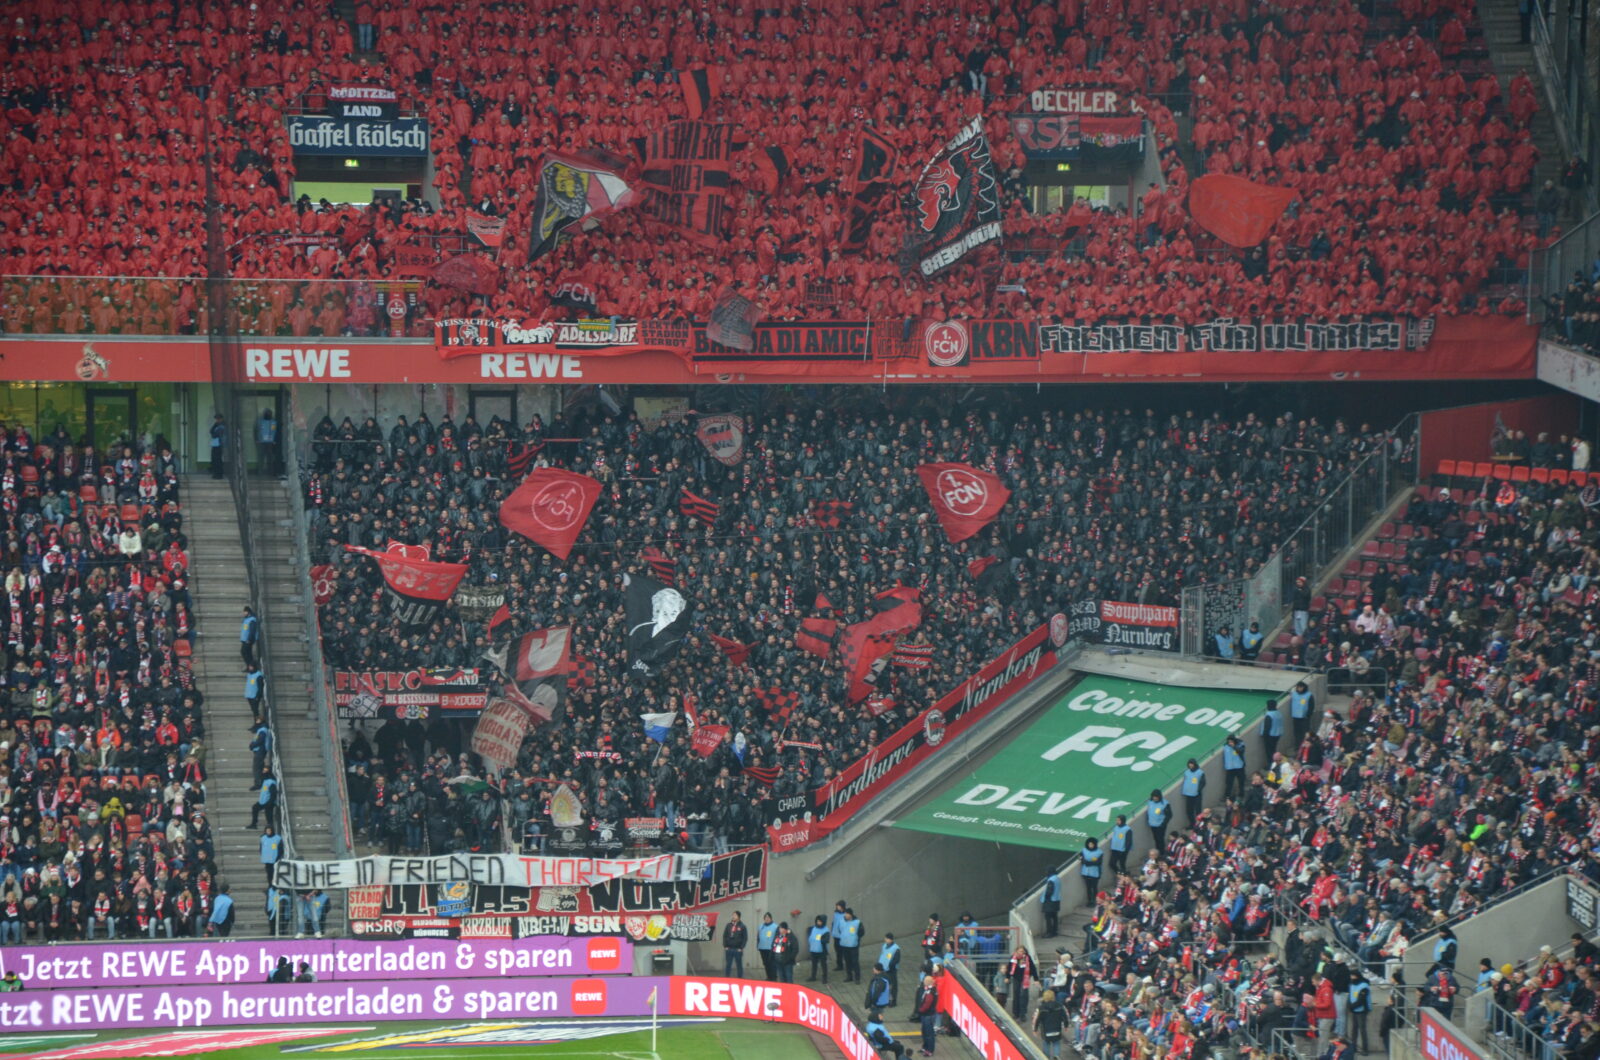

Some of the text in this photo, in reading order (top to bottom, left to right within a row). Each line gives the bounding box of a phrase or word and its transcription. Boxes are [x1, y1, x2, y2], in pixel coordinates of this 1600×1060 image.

[343, 105, 382, 117] LAND
[1031, 90, 1118, 113] OECHLER
[289, 122, 426, 150] Gaffel Kölsch
[1012, 114, 1080, 150] RSE
[434, 319, 501, 329] WEISSACHTAL
[558, 325, 637, 343] ADELSDORF
[642, 330, 689, 338] STADION
[941, 329, 952, 340] 1.
[1039, 325, 1184, 352] FREIHEIT
[1192, 318, 1257, 351] FÜR
[1263, 323, 1401, 351] ULTRAS!
[447, 337, 489, 346] 19 92
[643, 338, 687, 347] VERBOT
[933, 340, 959, 353] FCN
[971, 322, 1037, 358] KBN
[246, 349, 352, 378] REWE
[480, 353, 583, 378] REWE
[945, 481, 984, 507] FCN
[1103, 623, 1172, 649] Nürnberg
[955, 646, 1041, 721] Nürnberg
[1068, 690, 1246, 733] Come on,
[1041, 725, 1198, 772] FC!
[820, 738, 915, 822] Nordkurve
[778, 795, 807, 812] CHAMPS
[953, 783, 1132, 823] DEVK
[933, 812, 978, 823] Gesagt.
[275, 861, 341, 887] RUHE
[388, 857, 504, 885] FRIEDEN
[574, 916, 621, 933] SGN
[18, 954, 92, 981] Jetzt
[101, 950, 187, 977] REWE
[195, 949, 250, 981] App
[456, 943, 476, 969] &
[484, 946, 573, 974] sparen
[590, 950, 616, 958] REWE
[0, 985, 558, 1027] tzt REWE App herunterladen & sparen
[575, 993, 602, 1002] REWE
[685, 981, 784, 1018] REWE
[798, 989, 830, 1029] Dein
